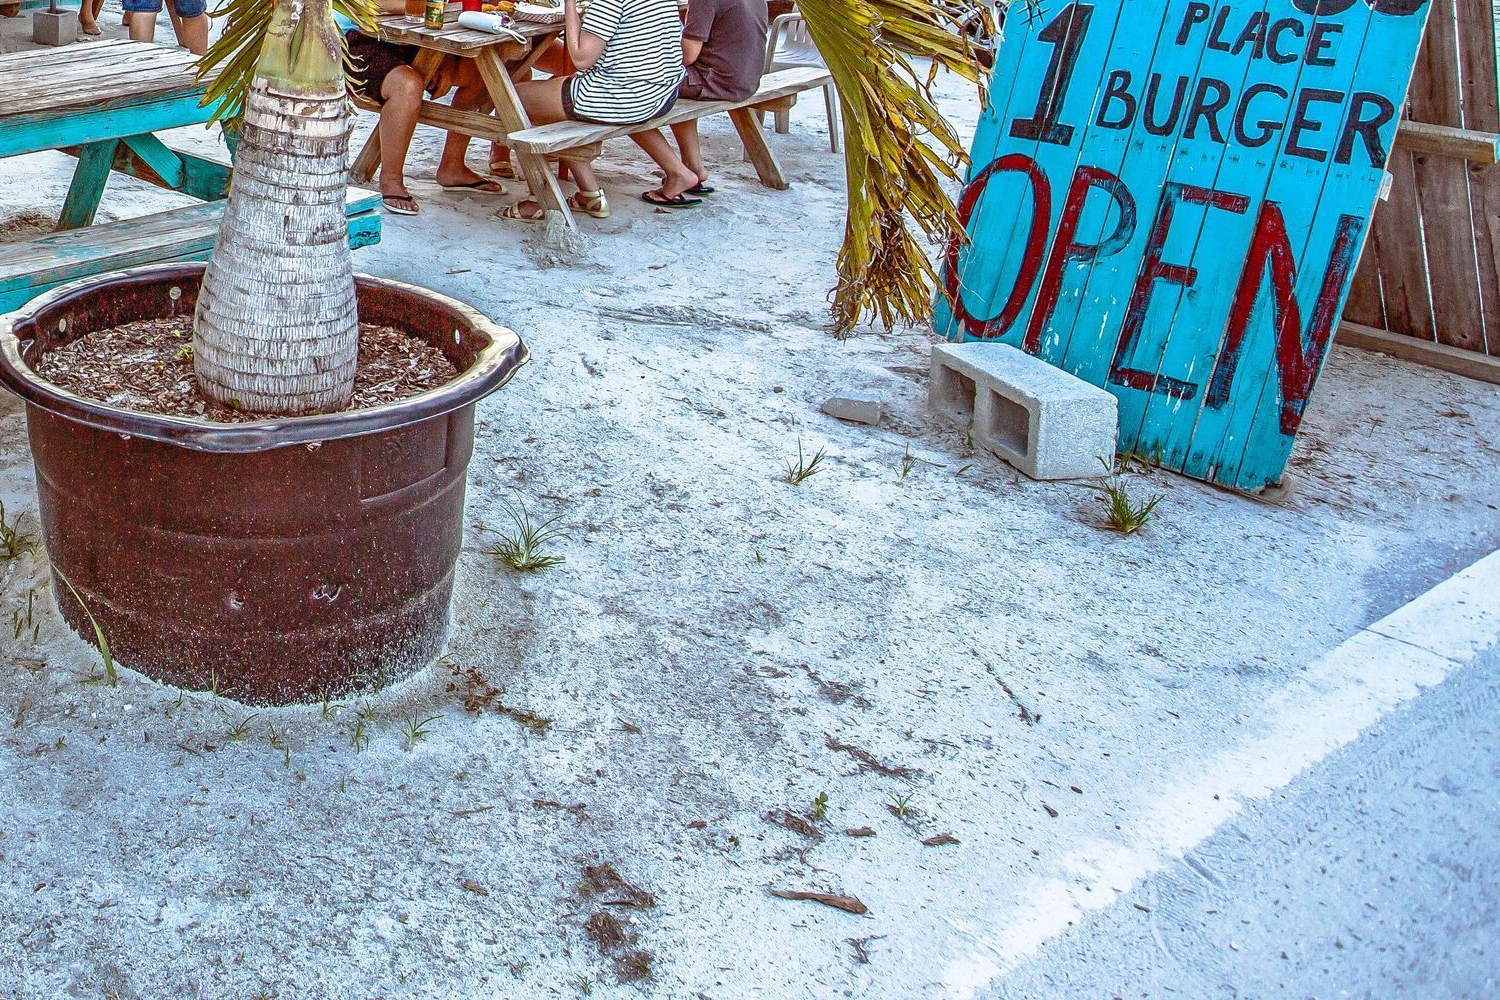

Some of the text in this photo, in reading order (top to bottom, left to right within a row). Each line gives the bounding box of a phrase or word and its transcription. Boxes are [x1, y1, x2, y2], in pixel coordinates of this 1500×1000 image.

[1176, 1, 1344, 67] PLACE
[1095, 69, 1395, 169] BURGER
[944, 152, 1366, 437] OPEN
